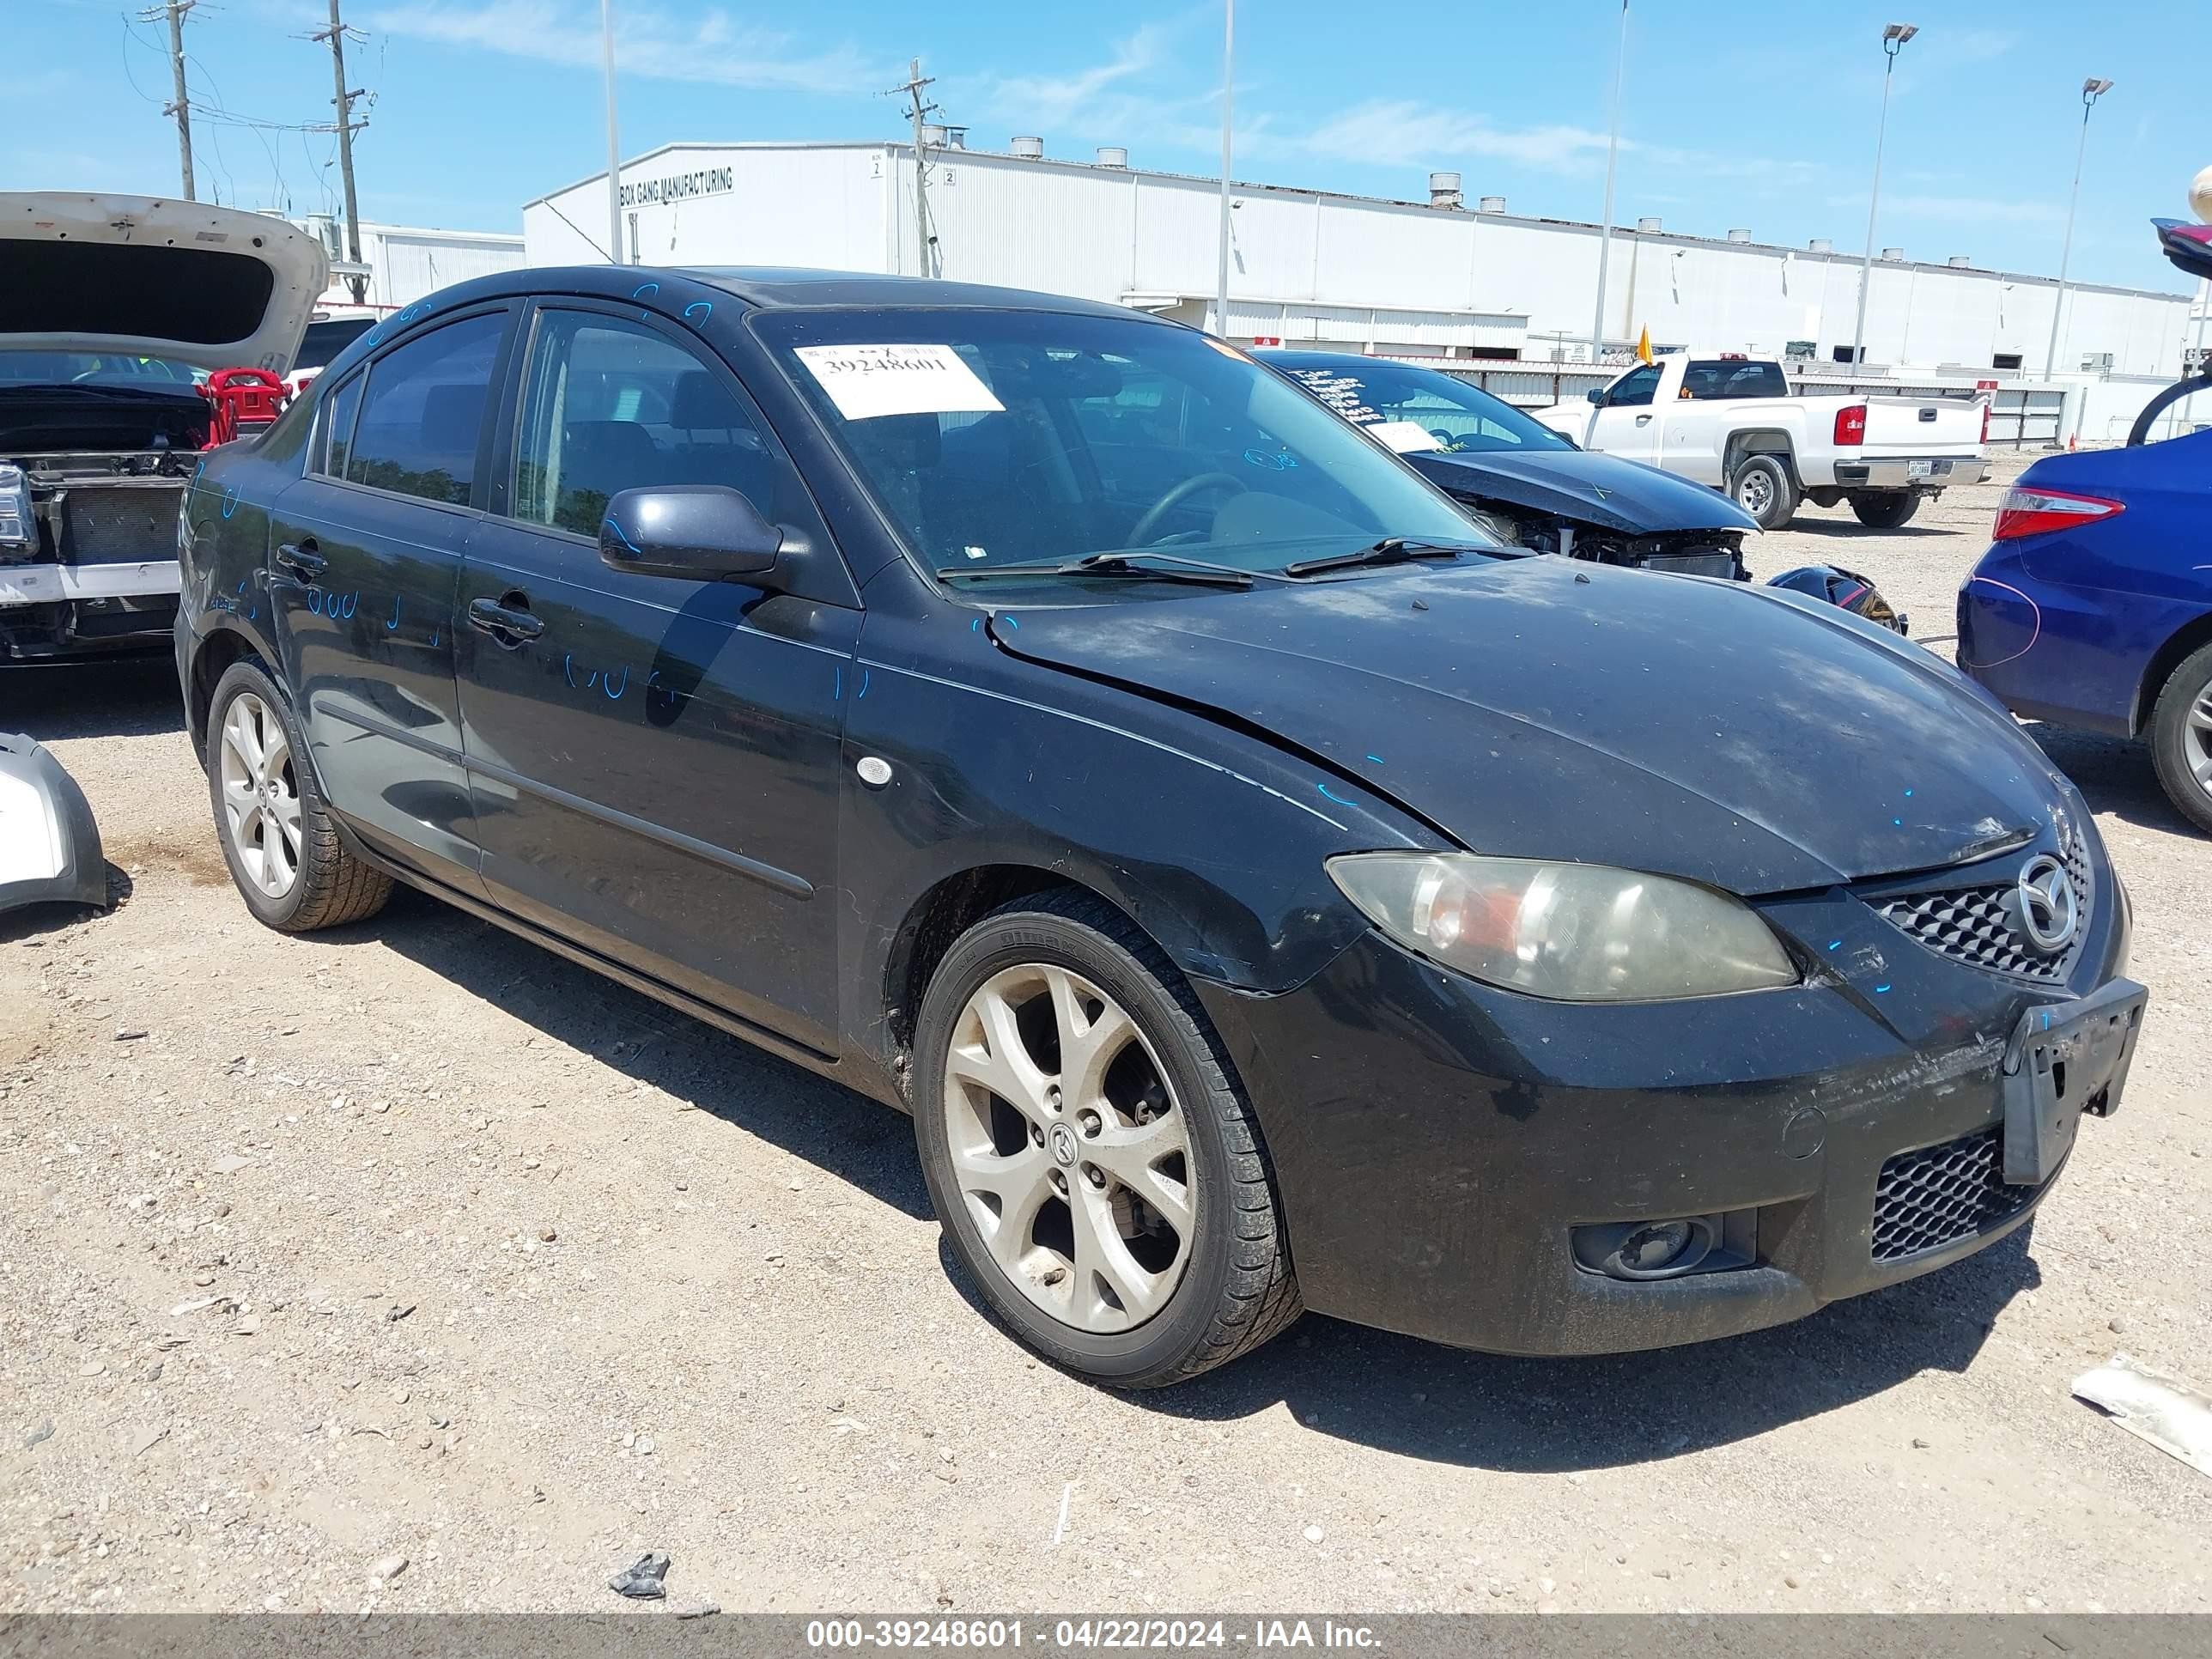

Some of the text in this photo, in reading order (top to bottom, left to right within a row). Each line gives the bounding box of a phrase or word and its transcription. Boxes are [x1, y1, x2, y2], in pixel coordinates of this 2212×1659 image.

[619, 166, 732, 206] BOX GANG MANUFACTURING
[823, 357, 948, 374] 39248601
